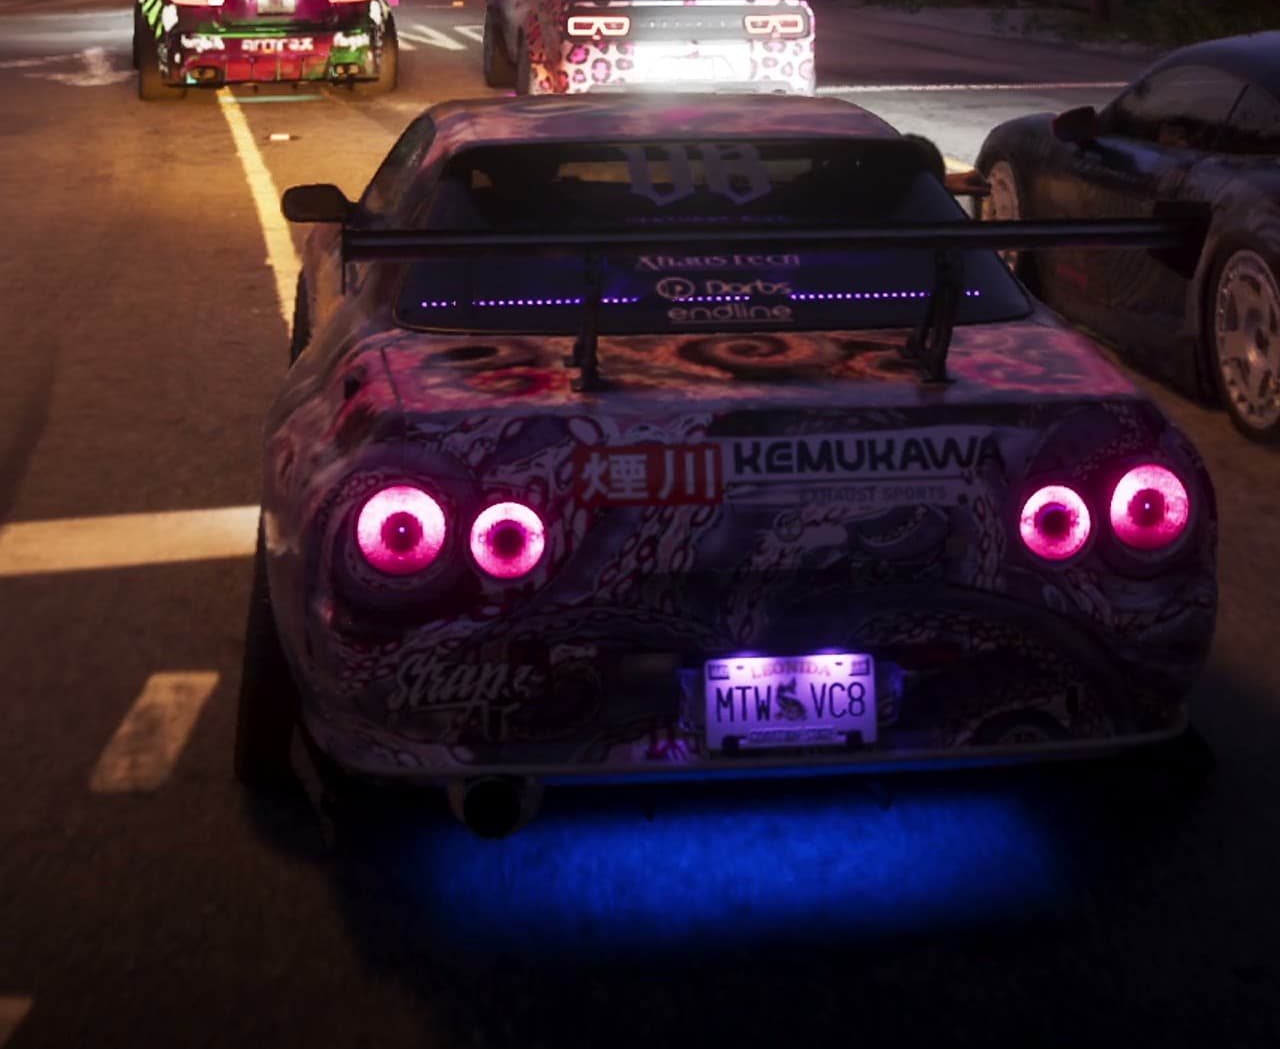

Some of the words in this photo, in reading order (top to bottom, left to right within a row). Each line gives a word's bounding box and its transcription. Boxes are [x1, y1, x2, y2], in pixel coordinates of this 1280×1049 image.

[733, 435, 1006, 475] KEMUKAWA
[751, 661, 831, 679] LEONIDA
[714, 685, 772, 723] MTW
[810, 681, 867, 719] VC8
